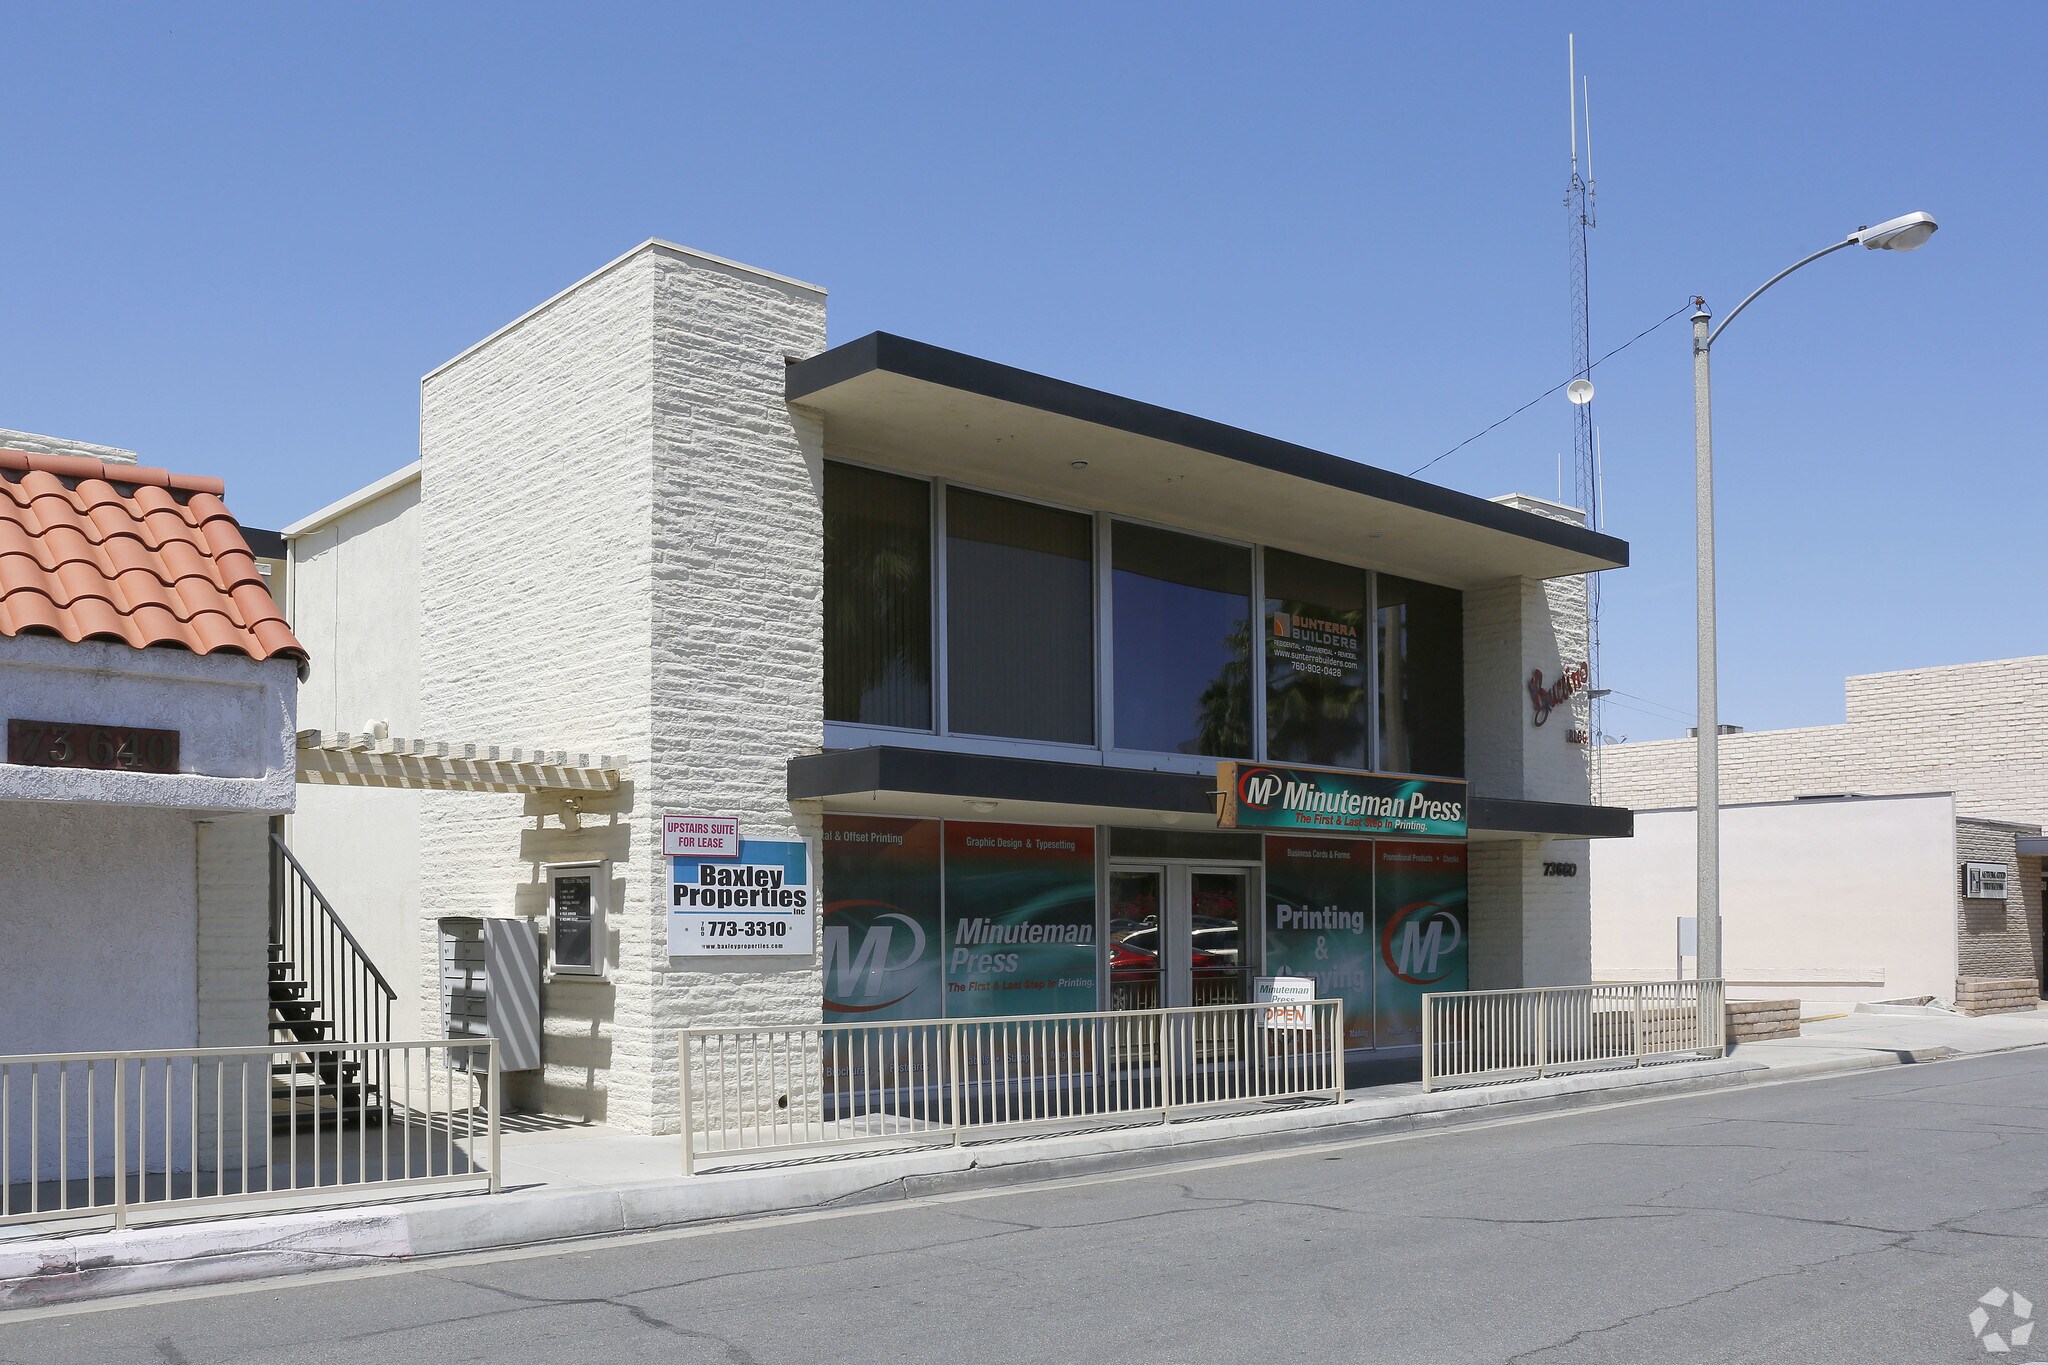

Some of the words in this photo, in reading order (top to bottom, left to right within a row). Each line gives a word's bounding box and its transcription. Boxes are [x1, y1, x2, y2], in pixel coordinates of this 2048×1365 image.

[1292, 628, 1357, 650] BUILDERS
[1273, 640, 1301, 650] RESIDENTIAL
[1305, 645, 1333, 656] COMMERCIAL
[1273, 649, 1358, 670] www.sunterrabuilders.com
[1283, 781, 1405, 818] Minuteman
[1408, 792, 1462, 822] Press
[667, 822, 709, 834] UPSTAIRS
[711, 824, 735, 835] SUITE
[1295, 812, 1312, 824] The
[1314, 814, 1334, 825] First
[1336, 816, 1342, 826] &
[1344, 817, 1362, 827] Last
[1364, 818, 1382, 829] Step
[1394, 820, 1428, 833] Printing.
[678, 836, 695, 848] FOR
[697, 837, 724, 849] LEASE
[834, 831, 842, 841] &
[843, 831, 869, 842] Offset
[870, 832, 903, 846] Printing
[966, 837, 996, 848] Graphic
[997, 838, 1023, 849] Design
[1025, 839, 1032, 848] &
[1035, 839, 1076, 851] Typesetting
[1287, 848, 1312, 858] Business
[1312, 850, 1328, 859] Cards
[1328, 850, 1333, 859] &
[1334, 851, 1351, 859] Forms
[1383, 853, 1412, 862] Promotional
[1412, 854, 1433, 862] Products
[700, 865, 783, 889] Baxley
[673, 885, 807, 909] Properties
[1276, 904, 1364, 934] Printing
[708, 921, 787, 937] 773-3310
[955, 918, 1093, 945] Minuteman
[1314, 935, 1328, 960] &
[950, 947, 1019, 974] Press
[948, 982, 966, 992] The
[968, 981, 991, 991] First
[1002, 980, 1022, 990] Last
[1024, 979, 1044, 990] Step
[1058, 978, 1094, 989] Printing.
[1259, 984, 1309, 995] Minuteman
[1264, 1009, 1305, 1022] OPEN
